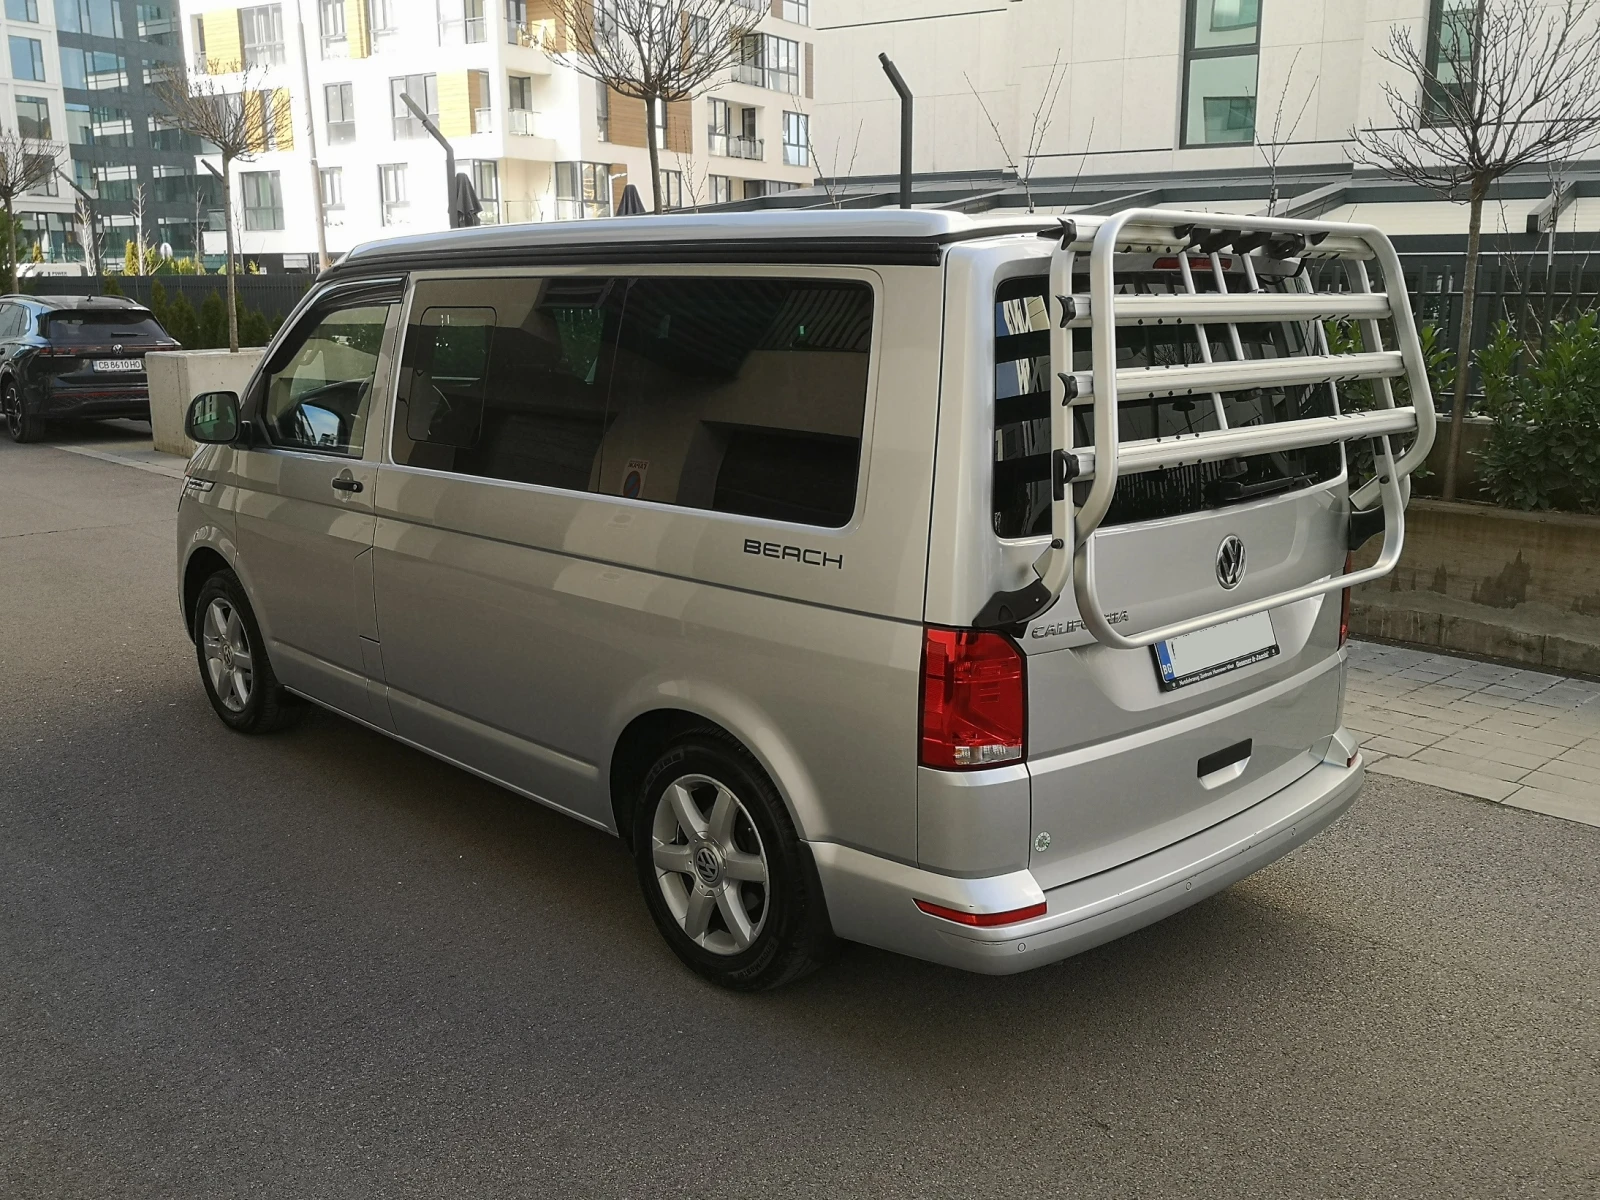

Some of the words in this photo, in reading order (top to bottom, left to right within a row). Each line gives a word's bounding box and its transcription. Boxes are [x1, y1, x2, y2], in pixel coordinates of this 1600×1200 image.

[98, 361, 109, 369] CB
[110, 361, 129, 369] 8610
[130, 361, 140, 369] HO
[743, 538, 843, 570] BEACH
[1162, 664, 1173, 674] BG
